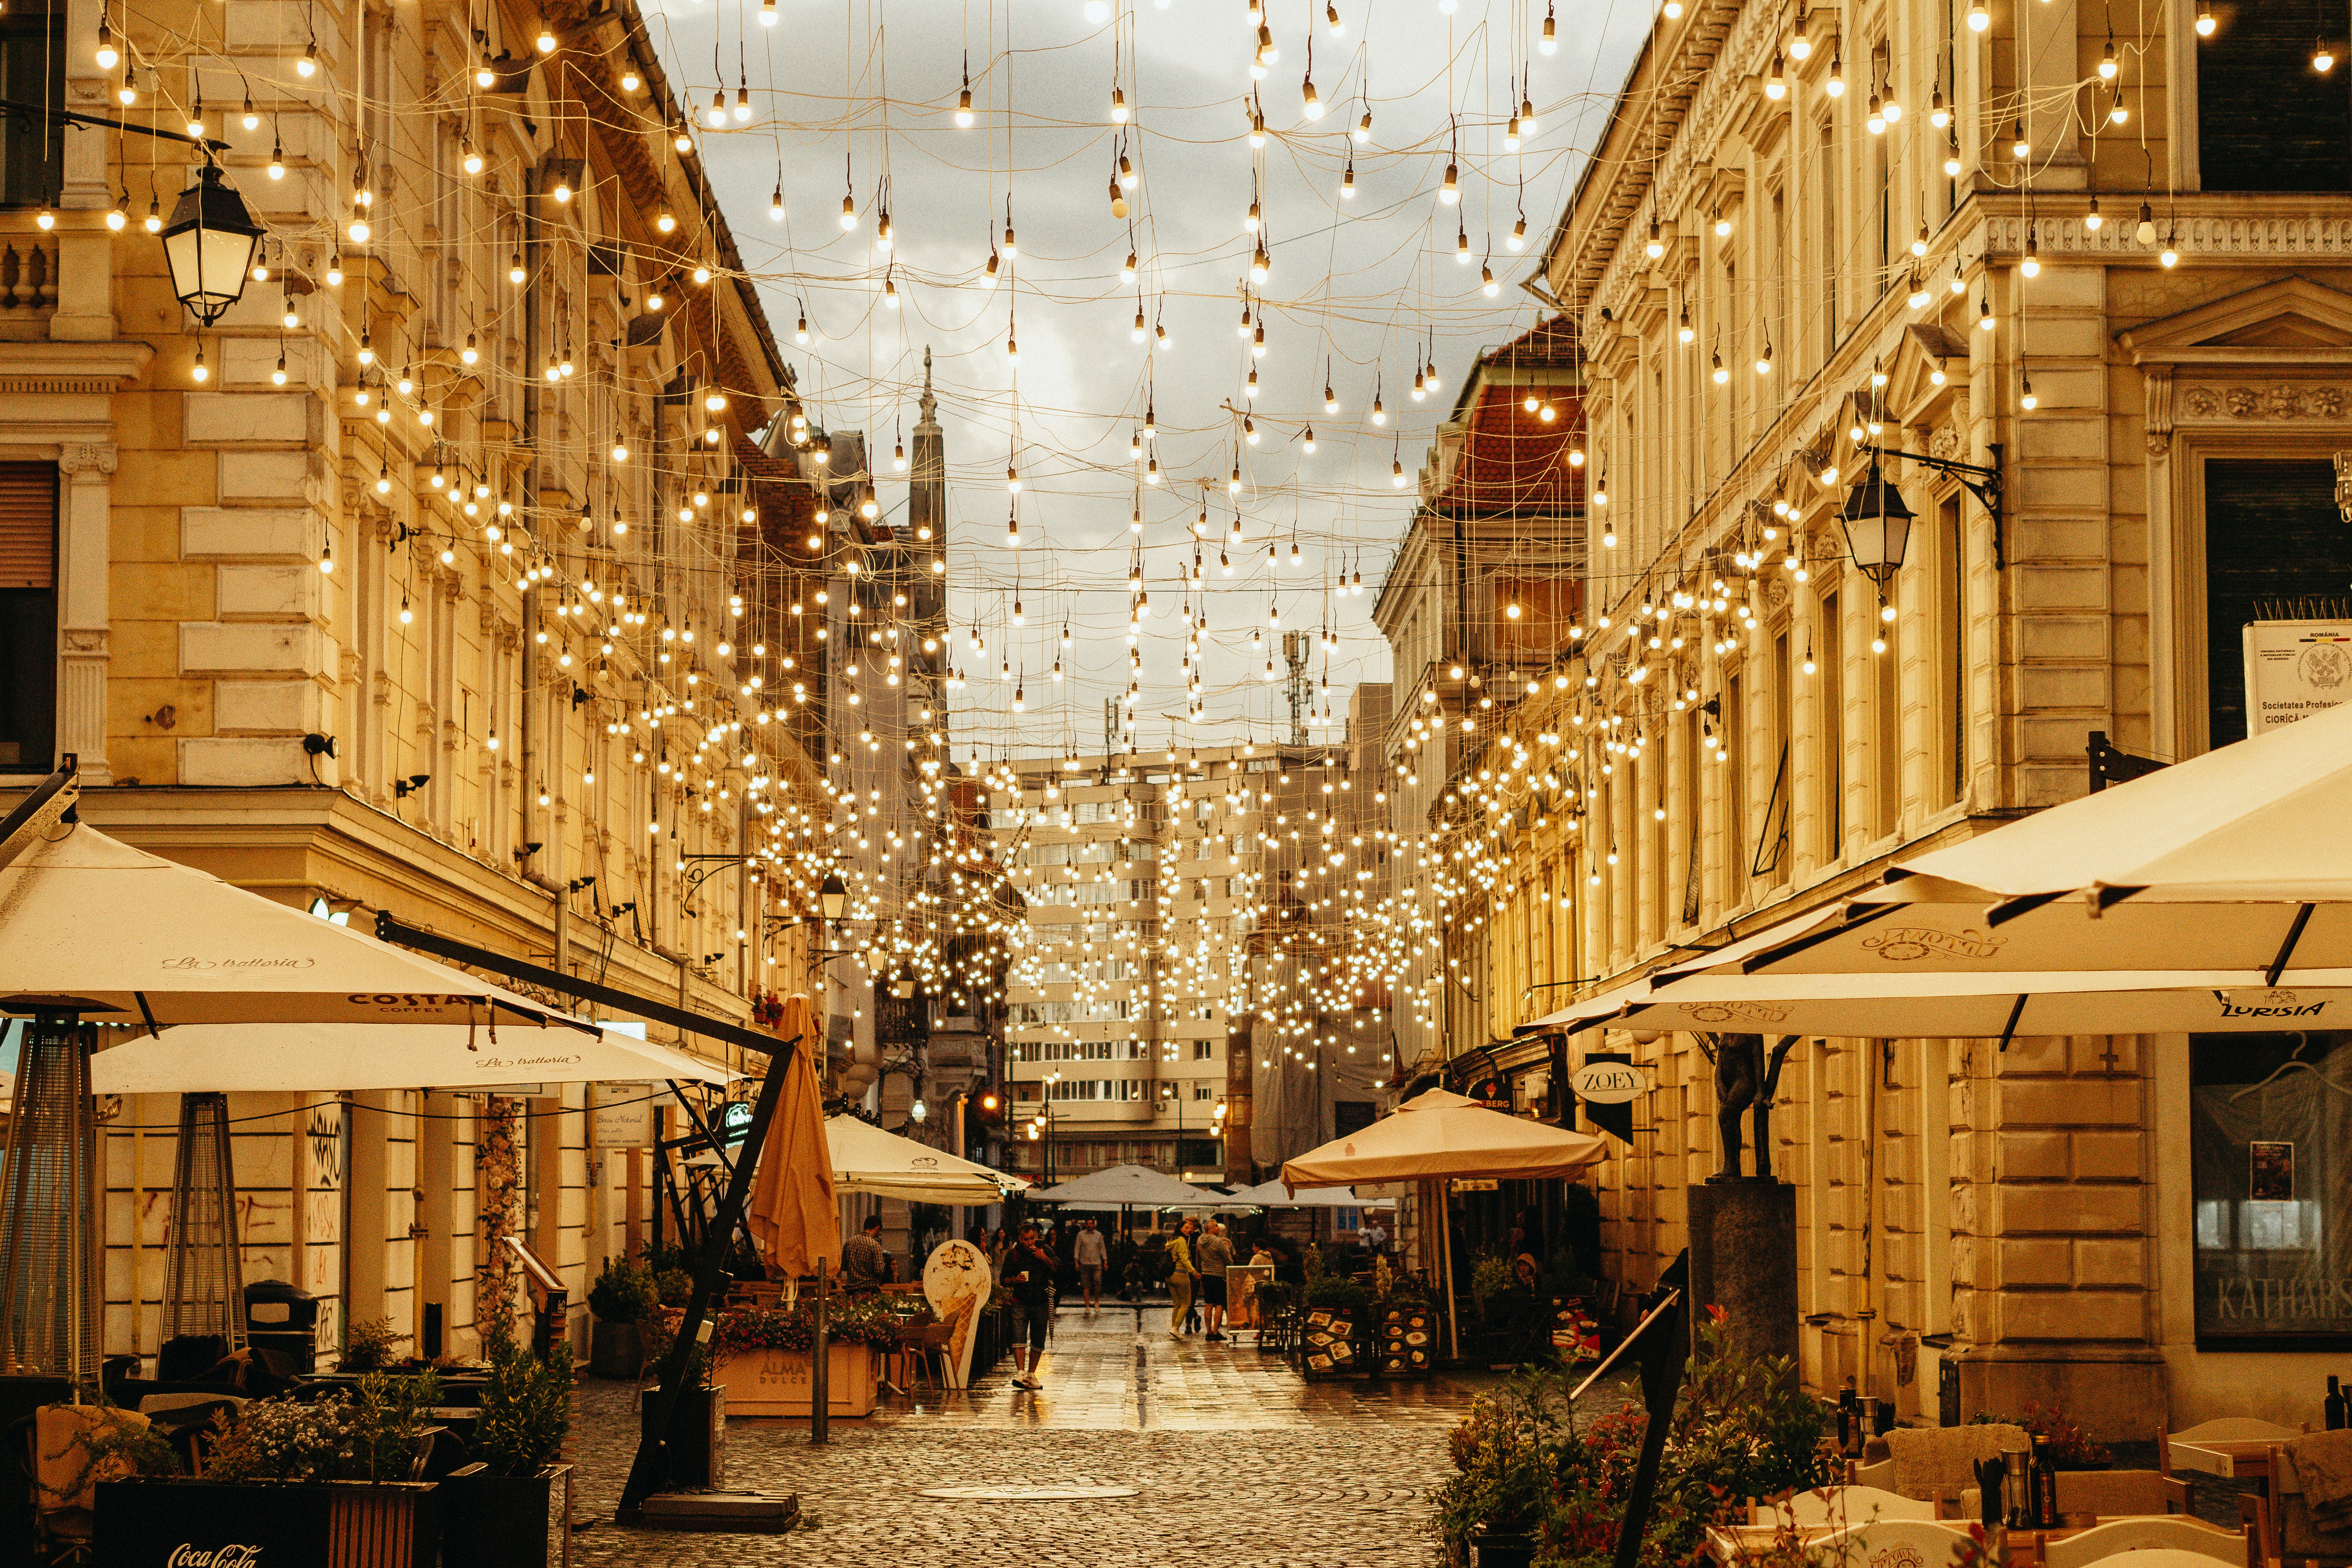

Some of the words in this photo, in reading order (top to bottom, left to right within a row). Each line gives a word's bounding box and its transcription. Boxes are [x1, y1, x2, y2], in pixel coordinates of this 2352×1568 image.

[2262, 701, 2303, 709] Societatea
[222, 957, 315, 969] trattoria
[348, 994, 468, 1006] COSTA
[2221, 1001, 2327, 1017] LURISIA
[476, 1058, 514, 1068] La
[517, 1054, 581, 1065] trattoria
[1584, 1072, 1638, 1090] ZOEY
